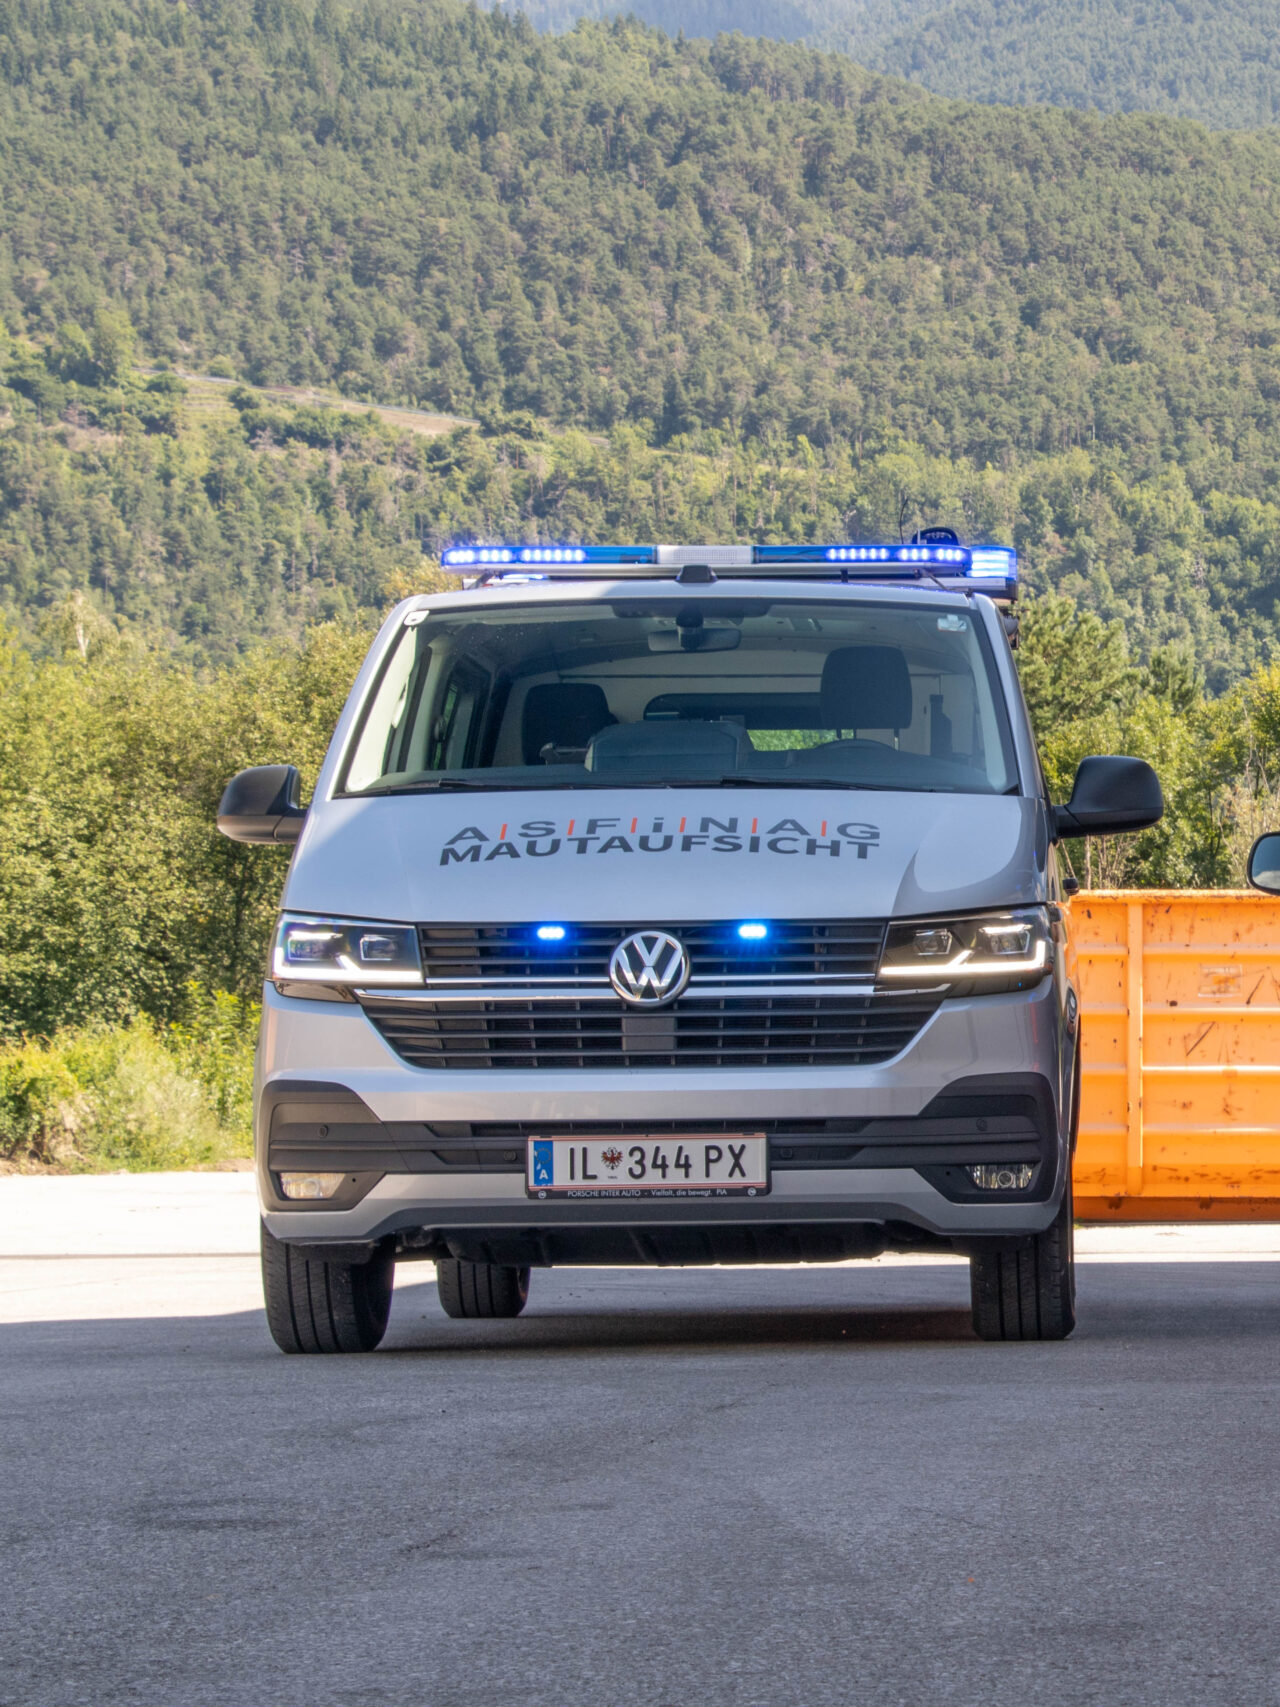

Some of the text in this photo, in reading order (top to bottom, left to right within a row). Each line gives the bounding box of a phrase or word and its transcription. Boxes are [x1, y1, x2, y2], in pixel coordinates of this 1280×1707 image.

[439, 833, 881, 866] MAUTAUFSICHT
[539, 1169, 548, 1180] A
[569, 1143, 747, 1180] IL 344 PX
